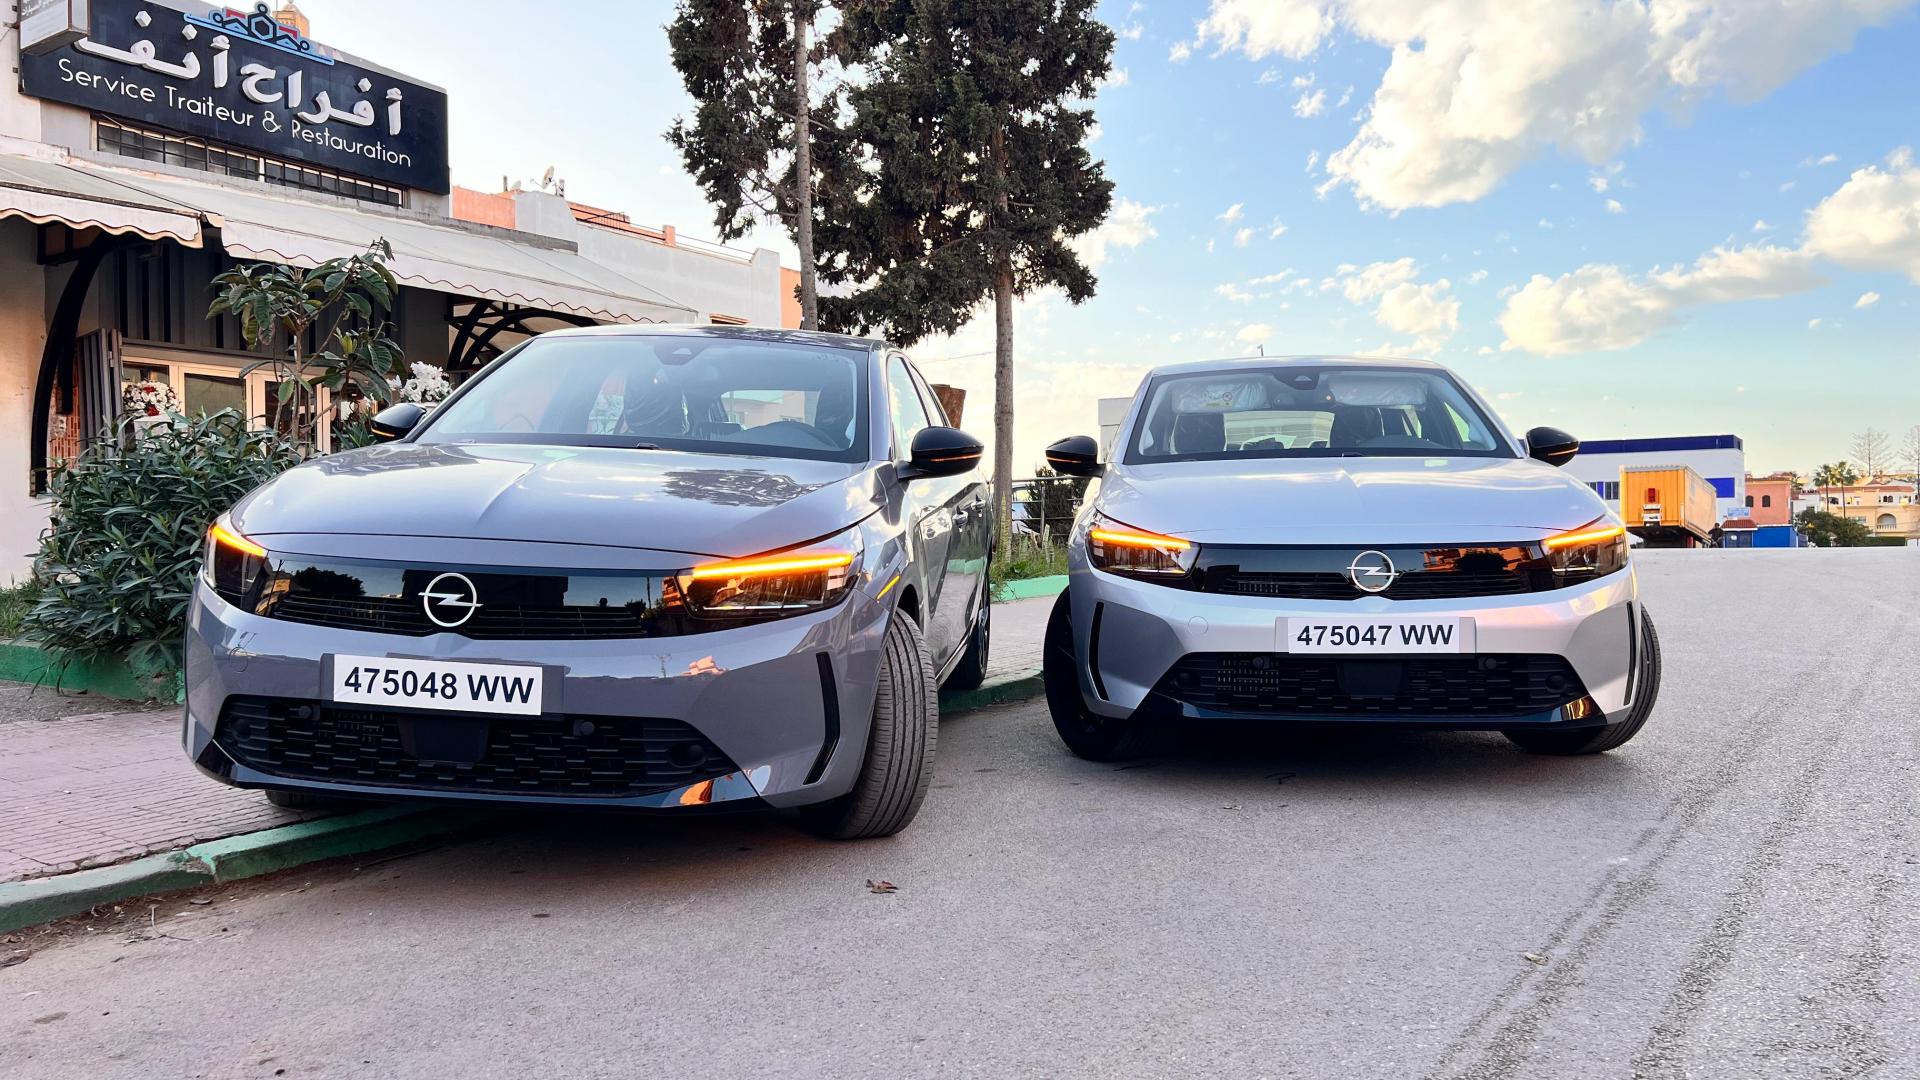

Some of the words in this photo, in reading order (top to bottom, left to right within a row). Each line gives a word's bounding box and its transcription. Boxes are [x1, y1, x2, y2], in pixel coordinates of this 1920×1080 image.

[74, 10, 230, 89] أنف
[58, 58, 155, 102] Service
[164, 85, 254, 127] Traiteur
[262, 110, 282, 133] &
[291, 119, 411, 167] Restauration
[240, 63, 402, 136] أفراح
[1296, 625, 1393, 646] 475047
[1400, 624, 1454, 645] WW
[344, 666, 458, 700] 475048
[467, 674, 535, 704] WW
